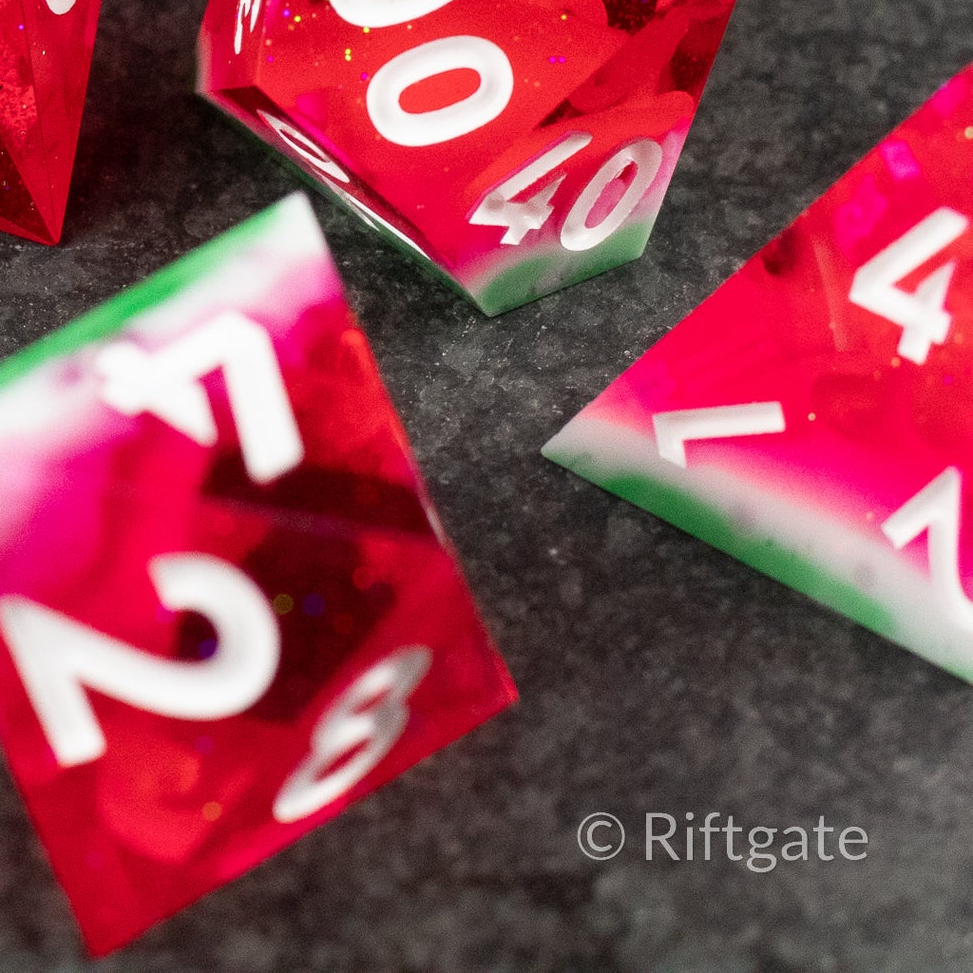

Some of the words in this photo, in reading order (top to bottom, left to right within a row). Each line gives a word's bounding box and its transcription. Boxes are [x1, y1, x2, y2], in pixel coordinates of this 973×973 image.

[468, 131, 662, 251] 40
[849, 207, 969, 365] 4
[97, 311, 305, 484] 4
[273, 644, 434, 824] 8
